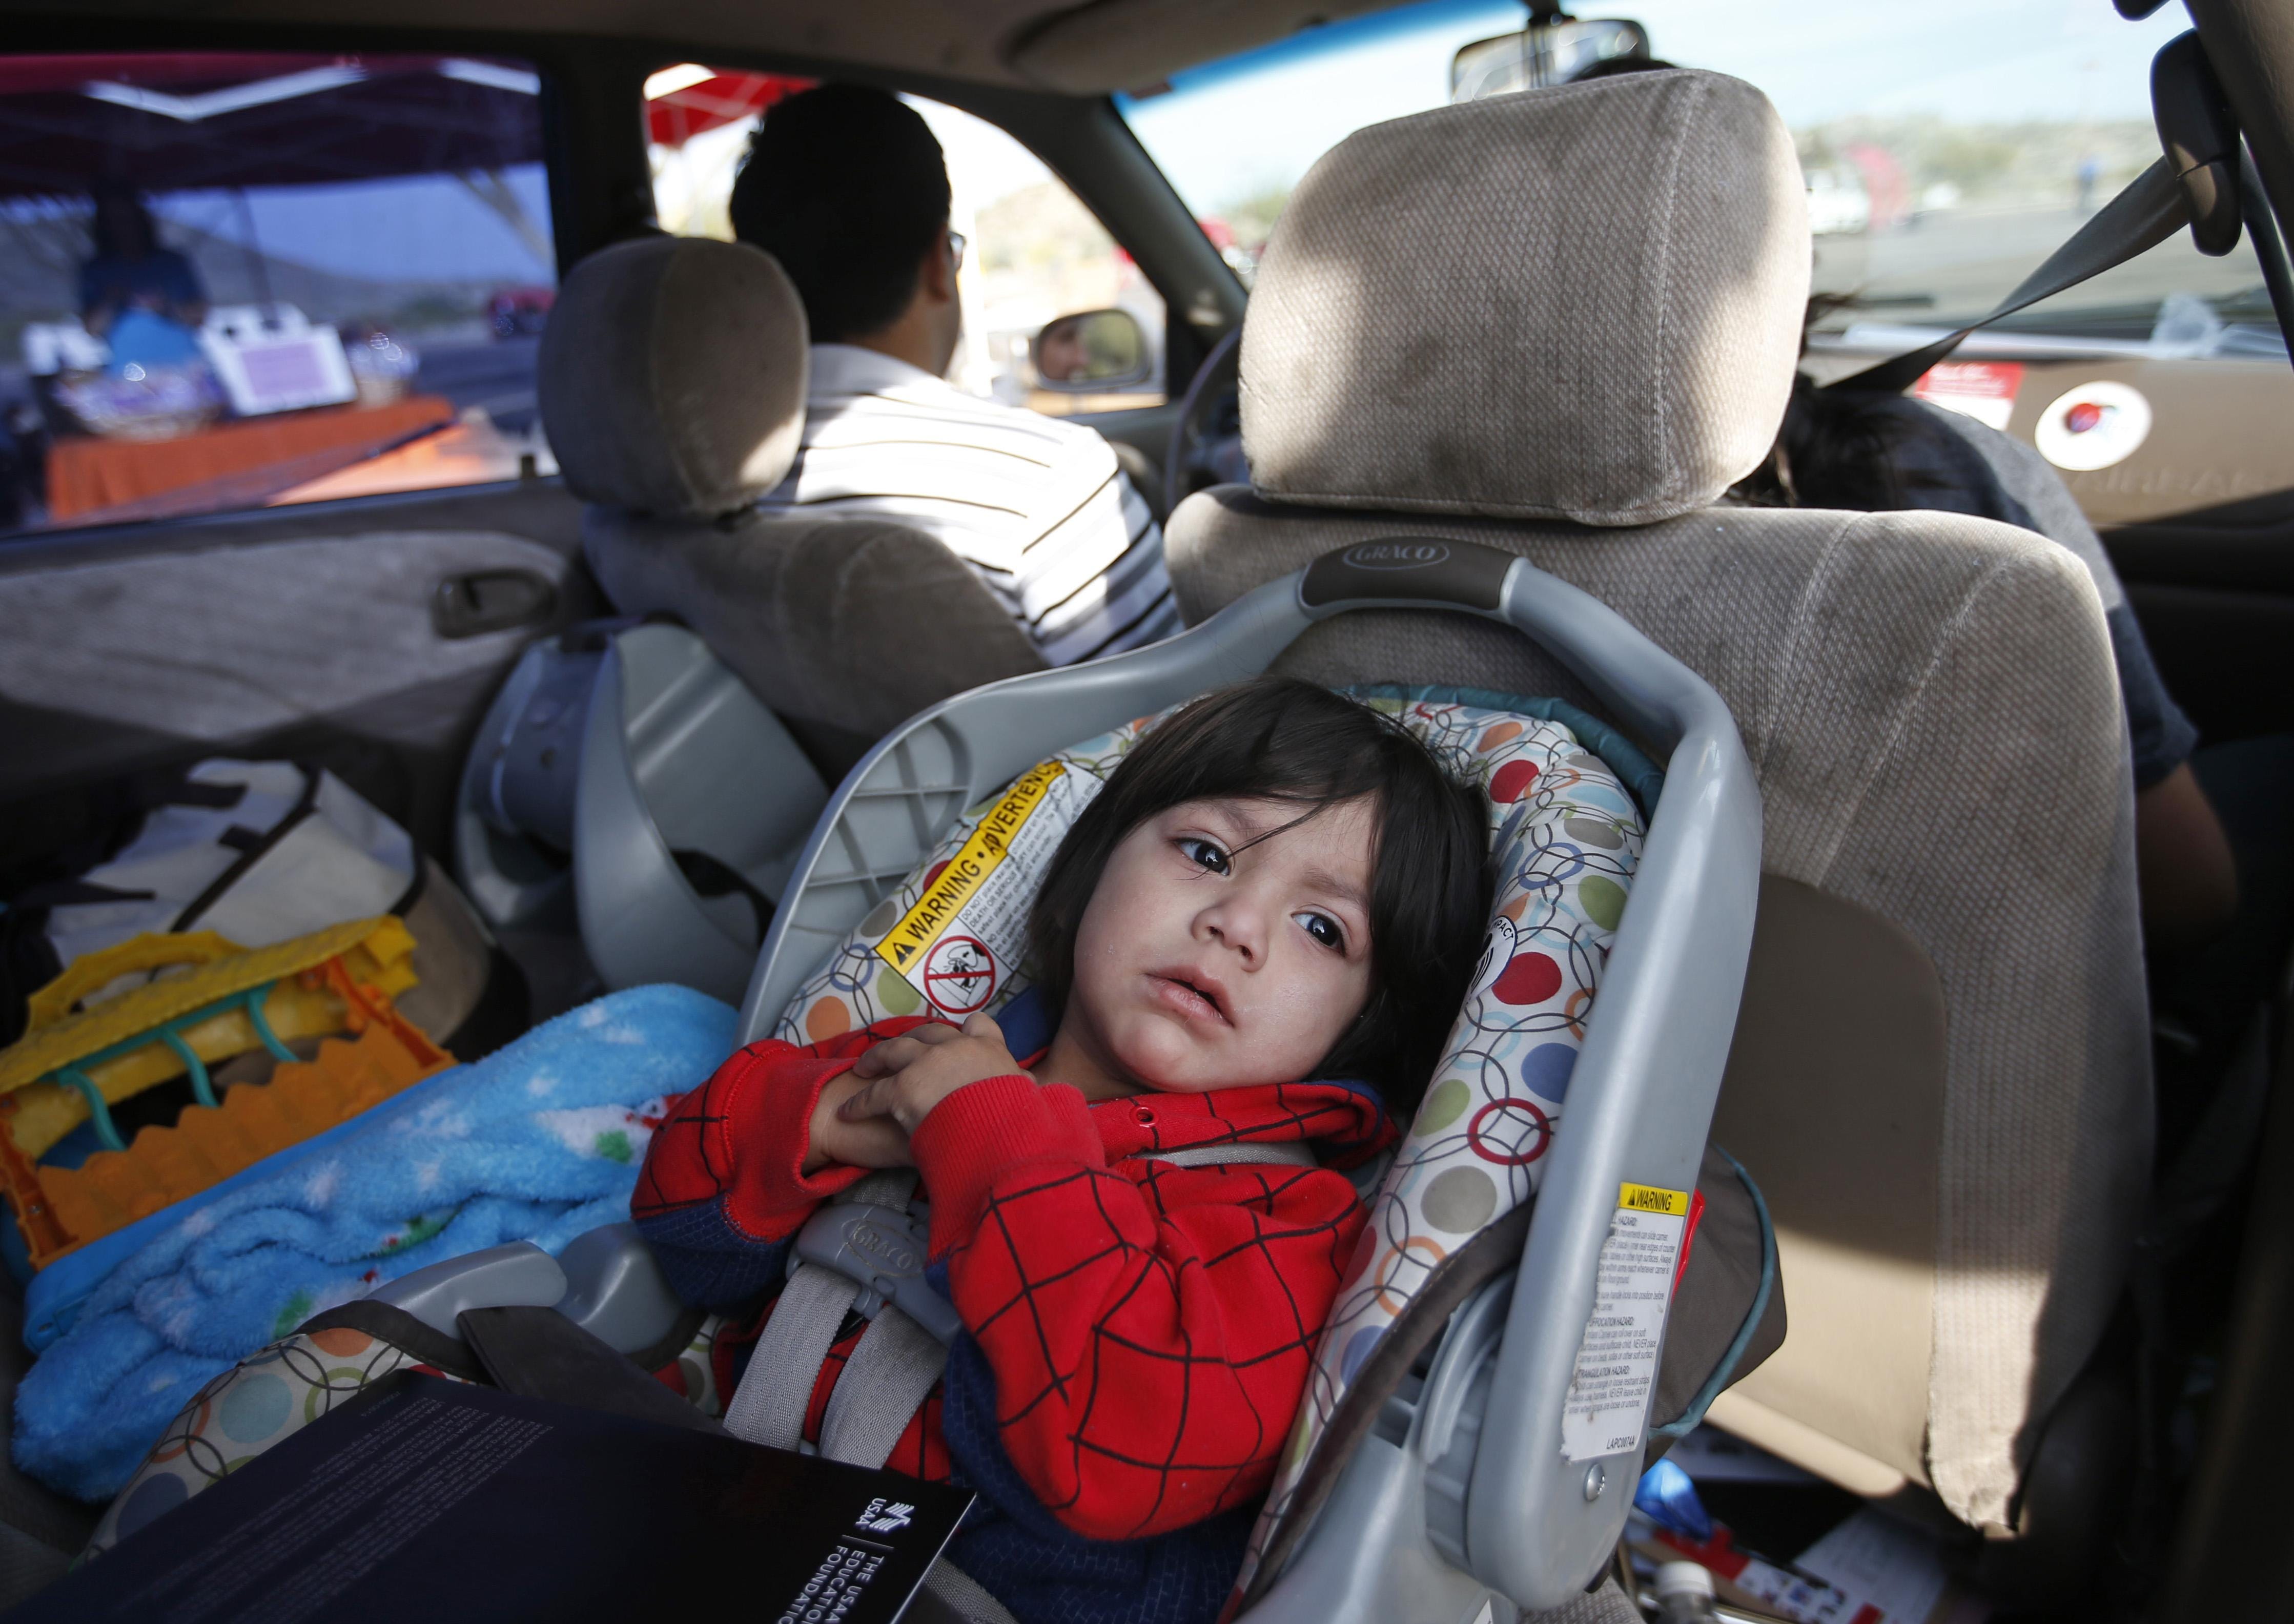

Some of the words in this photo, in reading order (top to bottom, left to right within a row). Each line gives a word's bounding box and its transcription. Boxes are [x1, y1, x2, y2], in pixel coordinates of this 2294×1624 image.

[1356, 545, 1436, 560] GRACO
[906, 859, 980, 941] WARNING
[981, 764, 1053, 855] ADVERTENC
[968, 904, 989, 928] DEATH
[986, 894, 997, 907] OR
[1637, 1189, 1672, 1210] WARNING
[853, 1225, 912, 1269] GRACO
[1633, 1338, 1647, 1348] NEVER
[1609, 1388, 1623, 1397] NEVER
[1606, 1435, 1634, 1449] LAPC0074A
[855, 1497, 887, 1526] USAA
[856, 1556, 884, 1582] THE
[801, 1551, 866, 1624] EDUCATIO
[824, 1586, 862, 1624] USAA
